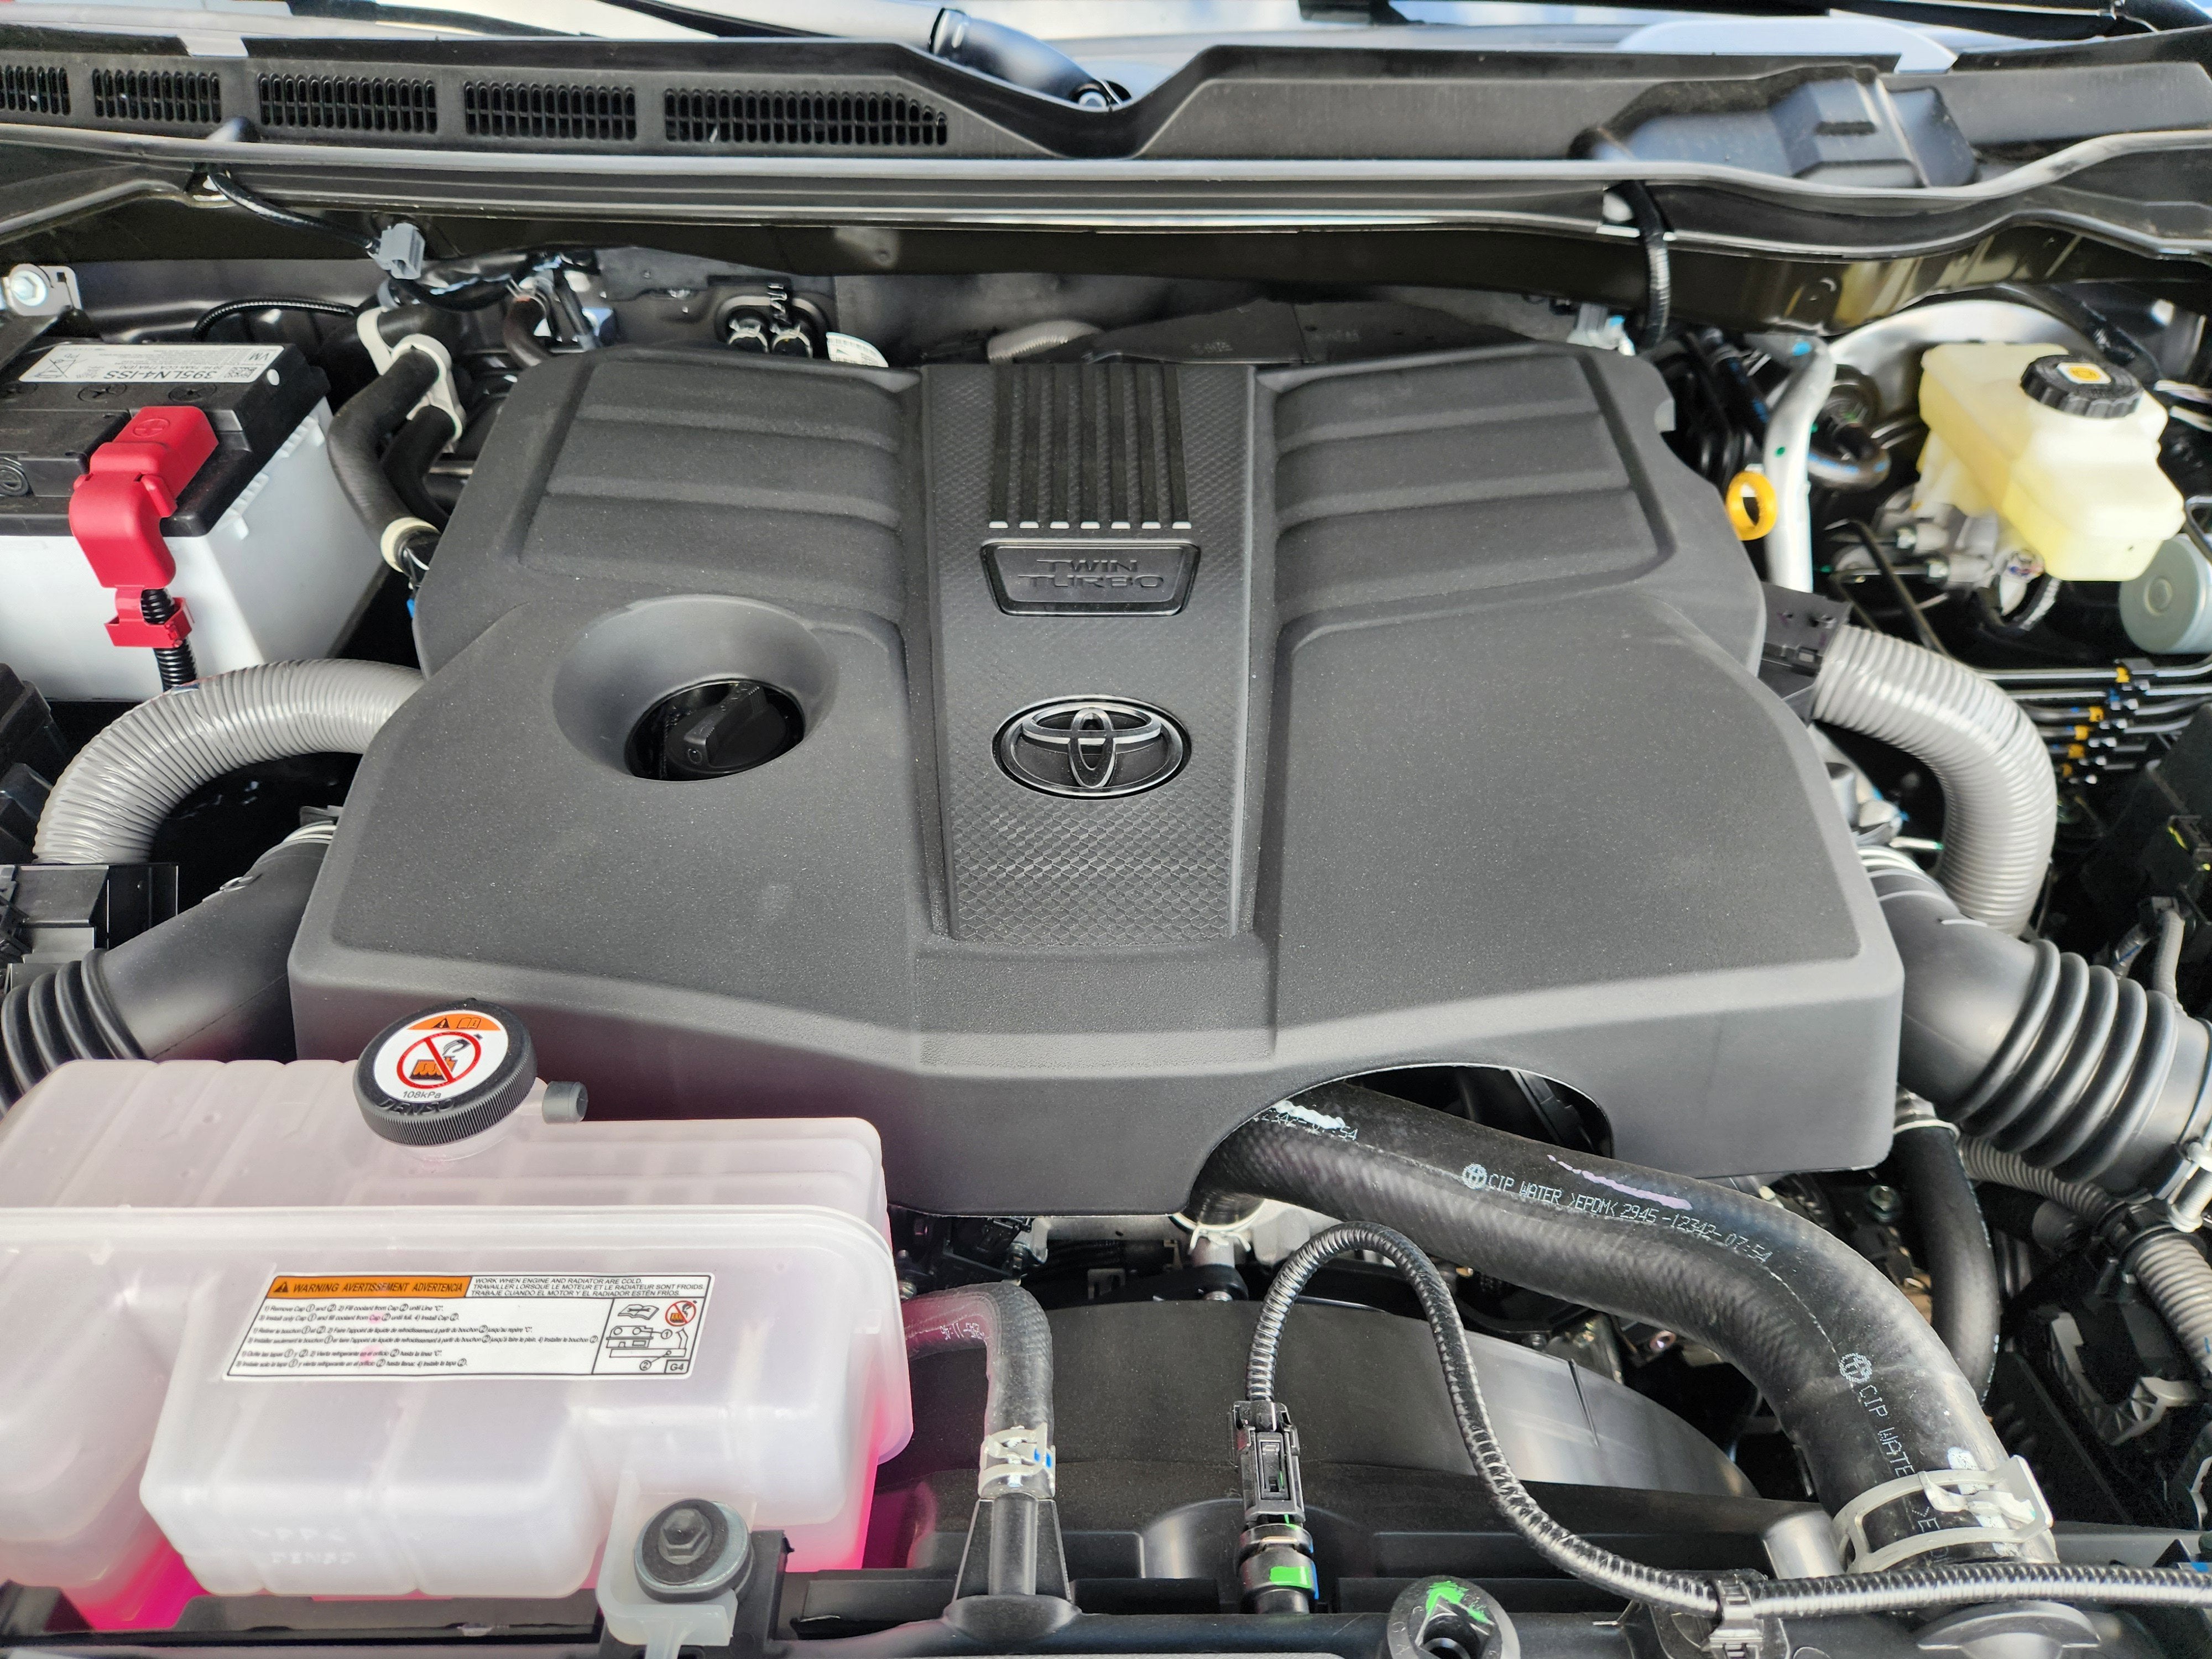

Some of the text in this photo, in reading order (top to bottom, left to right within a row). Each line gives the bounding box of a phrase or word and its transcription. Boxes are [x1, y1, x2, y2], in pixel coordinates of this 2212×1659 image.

[103, 371, 218, 379] 395LN4-ISS
[1037, 559, 1138, 573] TWIN
[1018, 575, 1164, 588] TURBO
[403, 1091, 442, 1099] 108kPa
[1488, 1173, 1515, 1192] CIP
[1519, 1180, 1564, 1206] WATER
[1620, 1203, 1660, 1223] 2945
[293, 1282, 463, 1293] WARNING AVERTISSEMENT ADVERTENCIA
[670, 1363, 684, 1371] G4
[1859, 1384, 1888, 1418] CIP
[1877, 1427, 1915, 1479] WATE
